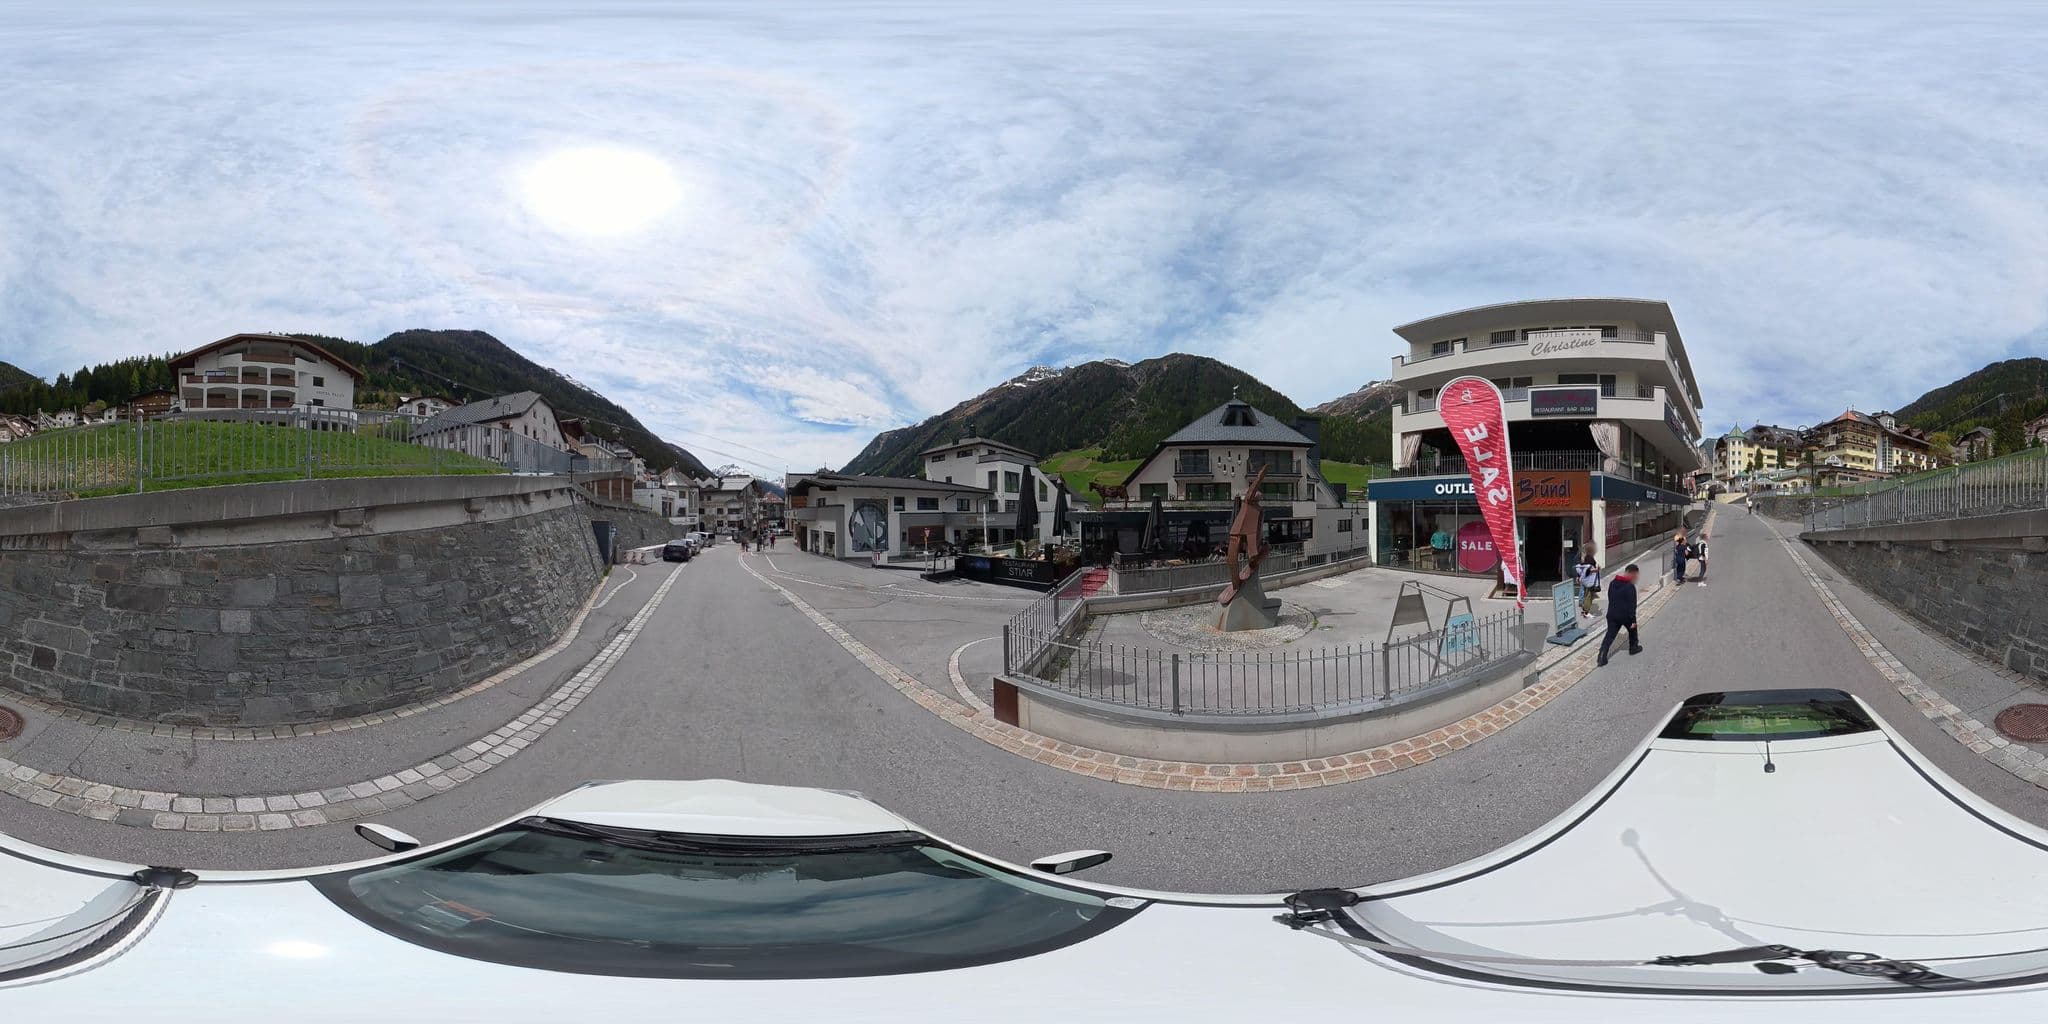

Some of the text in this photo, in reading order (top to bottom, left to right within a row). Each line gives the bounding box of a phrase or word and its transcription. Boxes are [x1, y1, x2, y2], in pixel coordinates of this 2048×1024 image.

[1531, 338, 1597, 357] Christine
[1464, 422, 1507, 505] SALE
[1435, 483, 1475, 495] OUTLE
[1534, 498, 1570, 506] SPORTS
[1461, 541, 1493, 551] SALE
